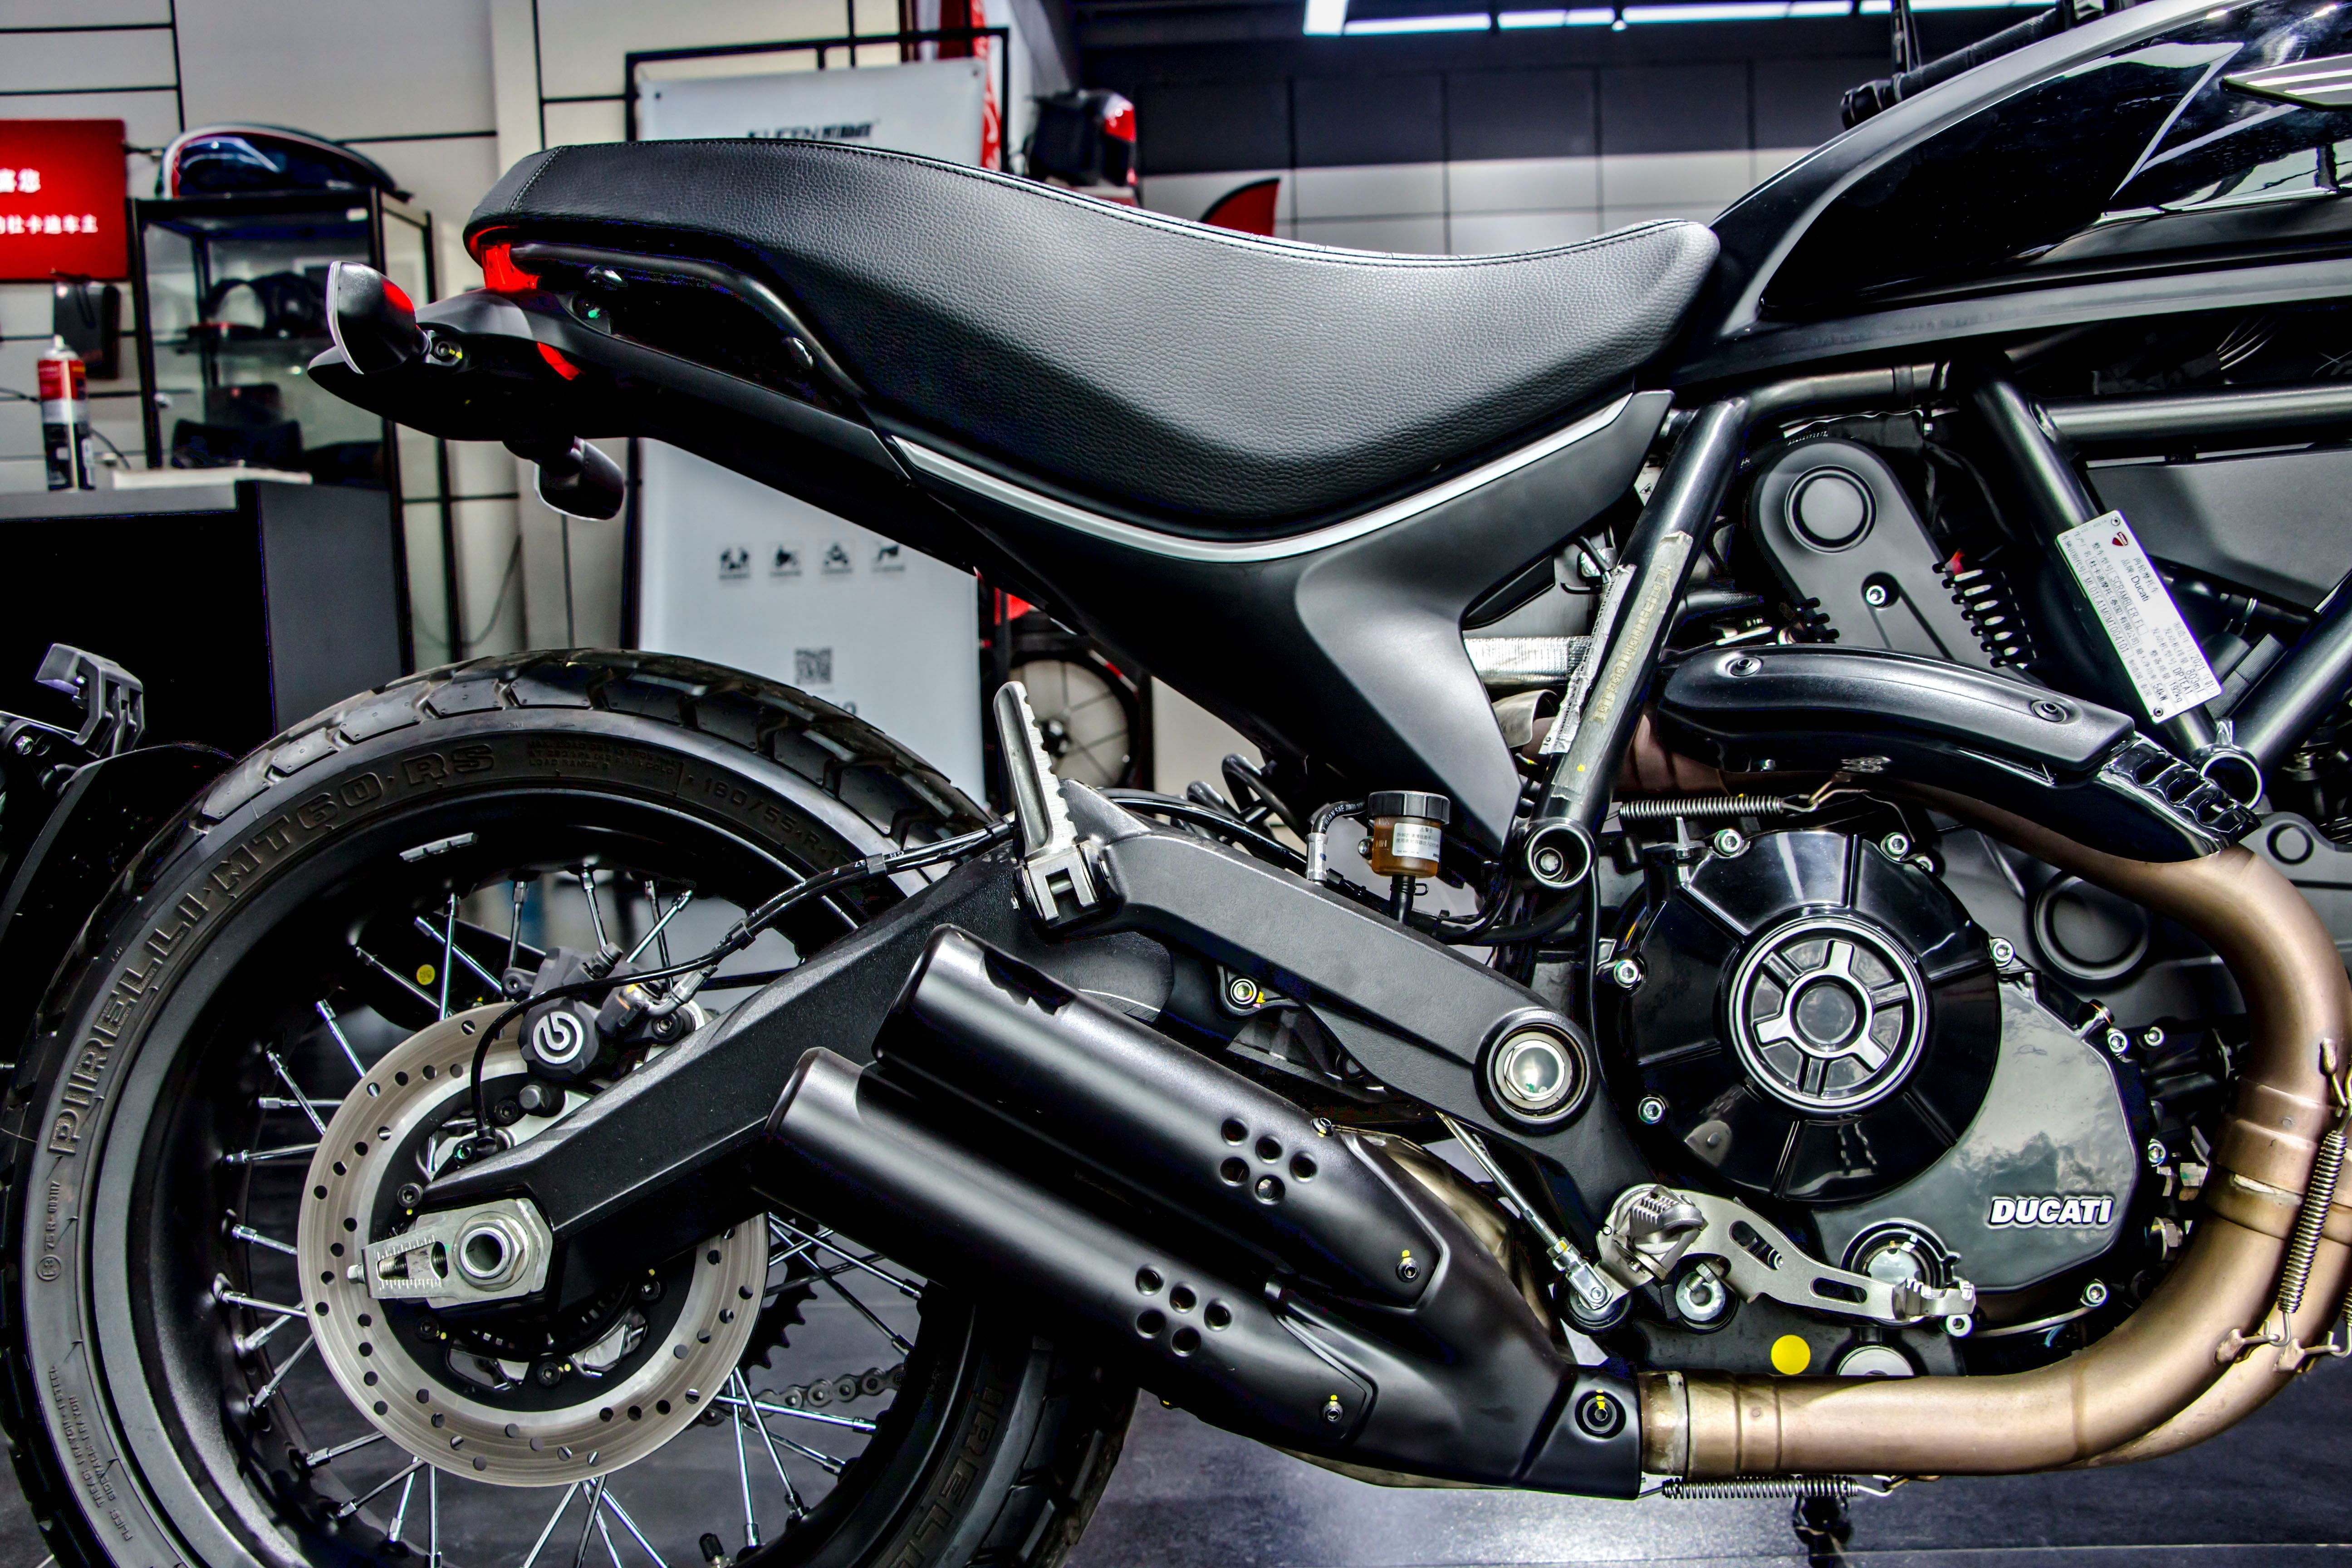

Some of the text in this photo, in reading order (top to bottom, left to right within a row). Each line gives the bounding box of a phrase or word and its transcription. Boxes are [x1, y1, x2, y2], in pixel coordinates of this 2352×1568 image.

[2108, 575, 2140, 619] SCRAMBLER
[2130, 574, 2152, 602] Ducati
[2190, 653, 2205, 672] 2021
[2151, 681, 2169, 703] 54kW
[2166, 681, 2185, 705] 192kg
[2171, 666, 2194, 696] DPTEA1
[48, 892, 210, 1155] PIRELLI
[402, 743, 495, 786] RS
[1989, 1198, 2114, 1225] DUCATI
